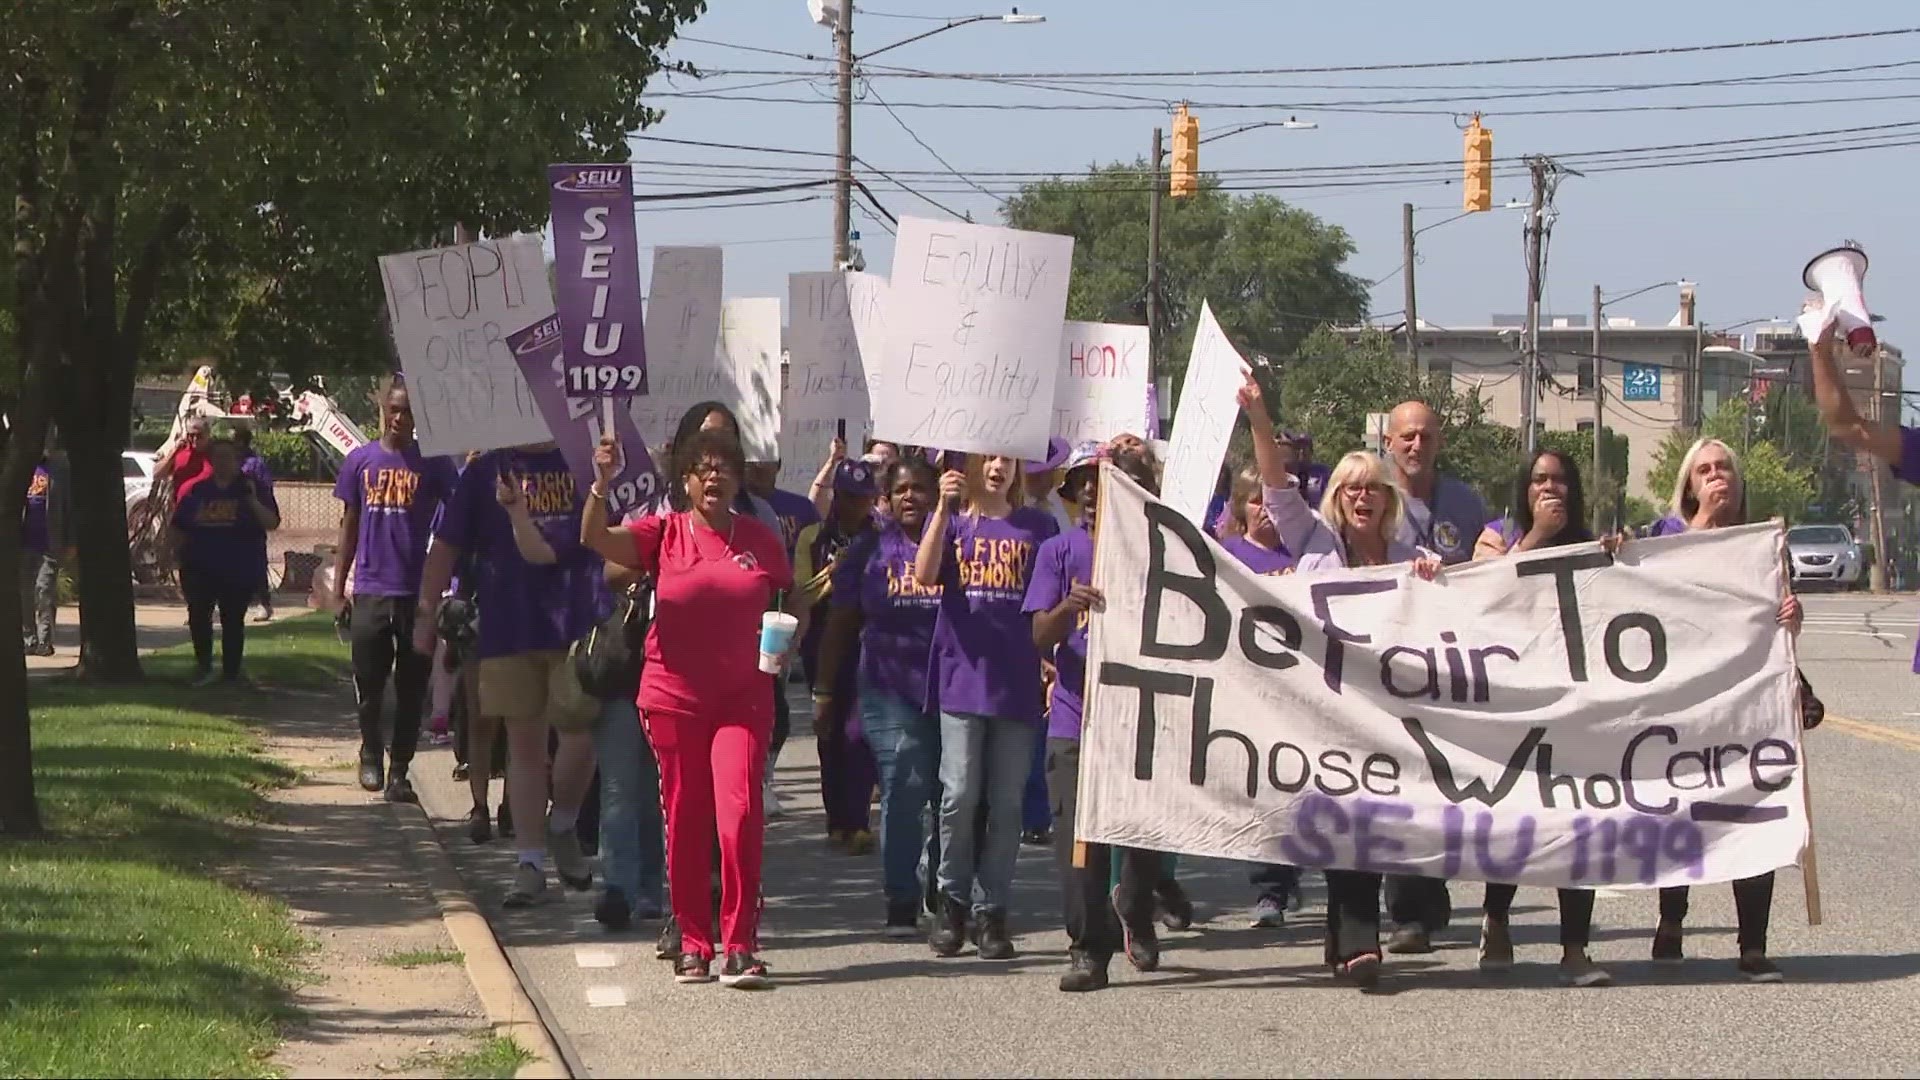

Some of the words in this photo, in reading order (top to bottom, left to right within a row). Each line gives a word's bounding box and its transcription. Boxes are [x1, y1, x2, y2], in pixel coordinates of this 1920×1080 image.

[576, 168, 622, 185] SEIU
[579, 206, 624, 358] SEIU
[922, 232, 1049, 302] Equity
[534, 321, 560, 342] SEI
[1070, 338, 1137, 379] Honk
[568, 364, 643, 392] 1199
[905, 341, 1040, 414] Equality
[1625, 386, 1657, 395] LOFTS
[1632, 368, 1657, 386] 25
[378, 467, 421, 492] FIGHT
[608, 471, 656, 512] 199
[528, 490, 574, 512] MONS
[974, 537, 1031, 567] FIGHT
[959, 560, 1024, 590] DEMONS
[1140, 501, 1302, 670] Be
[1310, 578, 1520, 703] Fair
[1516, 552, 1668, 684] To
[1100, 661, 1401, 799] Those
[1401, 716, 1622, 810] Who
[1620, 724, 1798, 816] Care
[1280, 793, 1537, 878] SEIU
[1570, 813, 1706, 885] 1199
